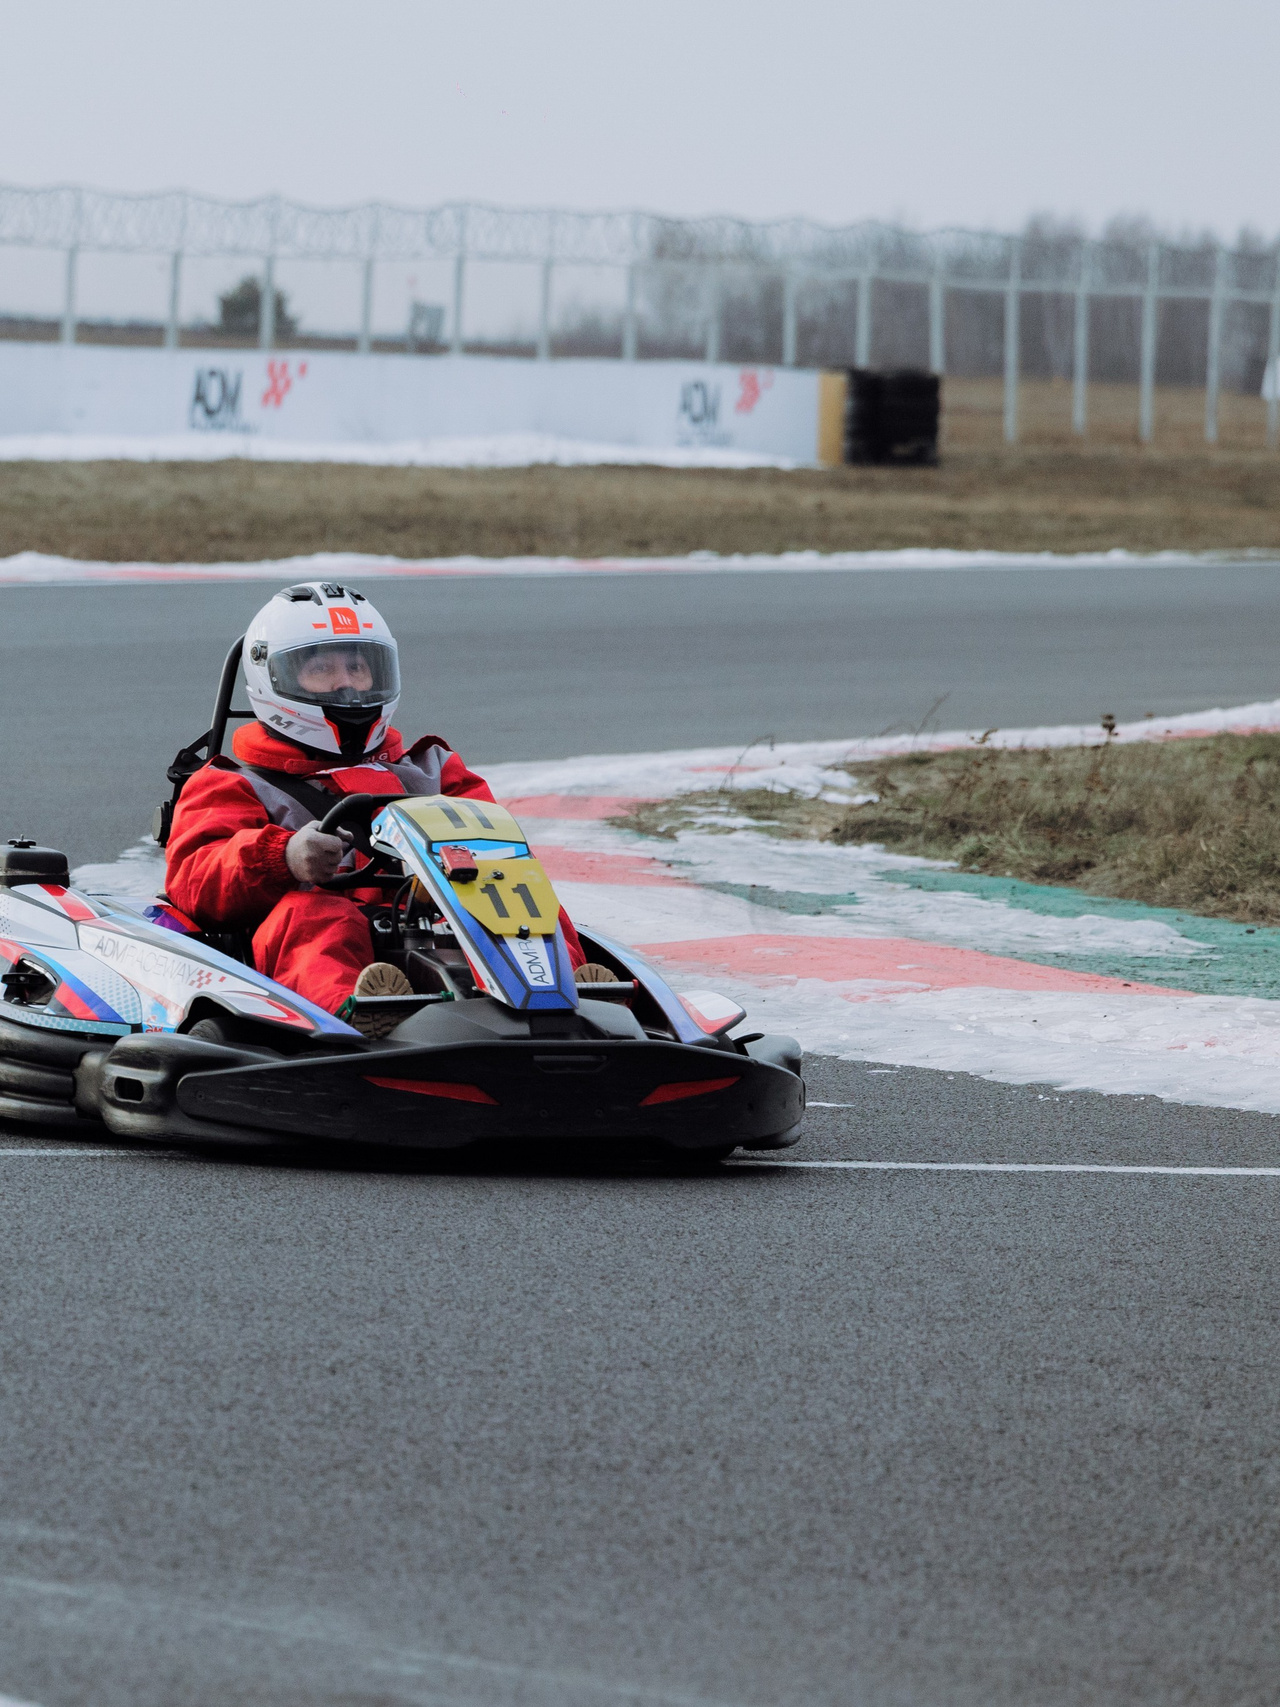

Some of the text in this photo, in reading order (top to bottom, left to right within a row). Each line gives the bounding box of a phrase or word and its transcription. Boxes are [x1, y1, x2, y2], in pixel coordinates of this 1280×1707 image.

[268, 714, 323, 736] MT
[425, 800, 495, 830] 11
[479, 883, 542, 918] 11
